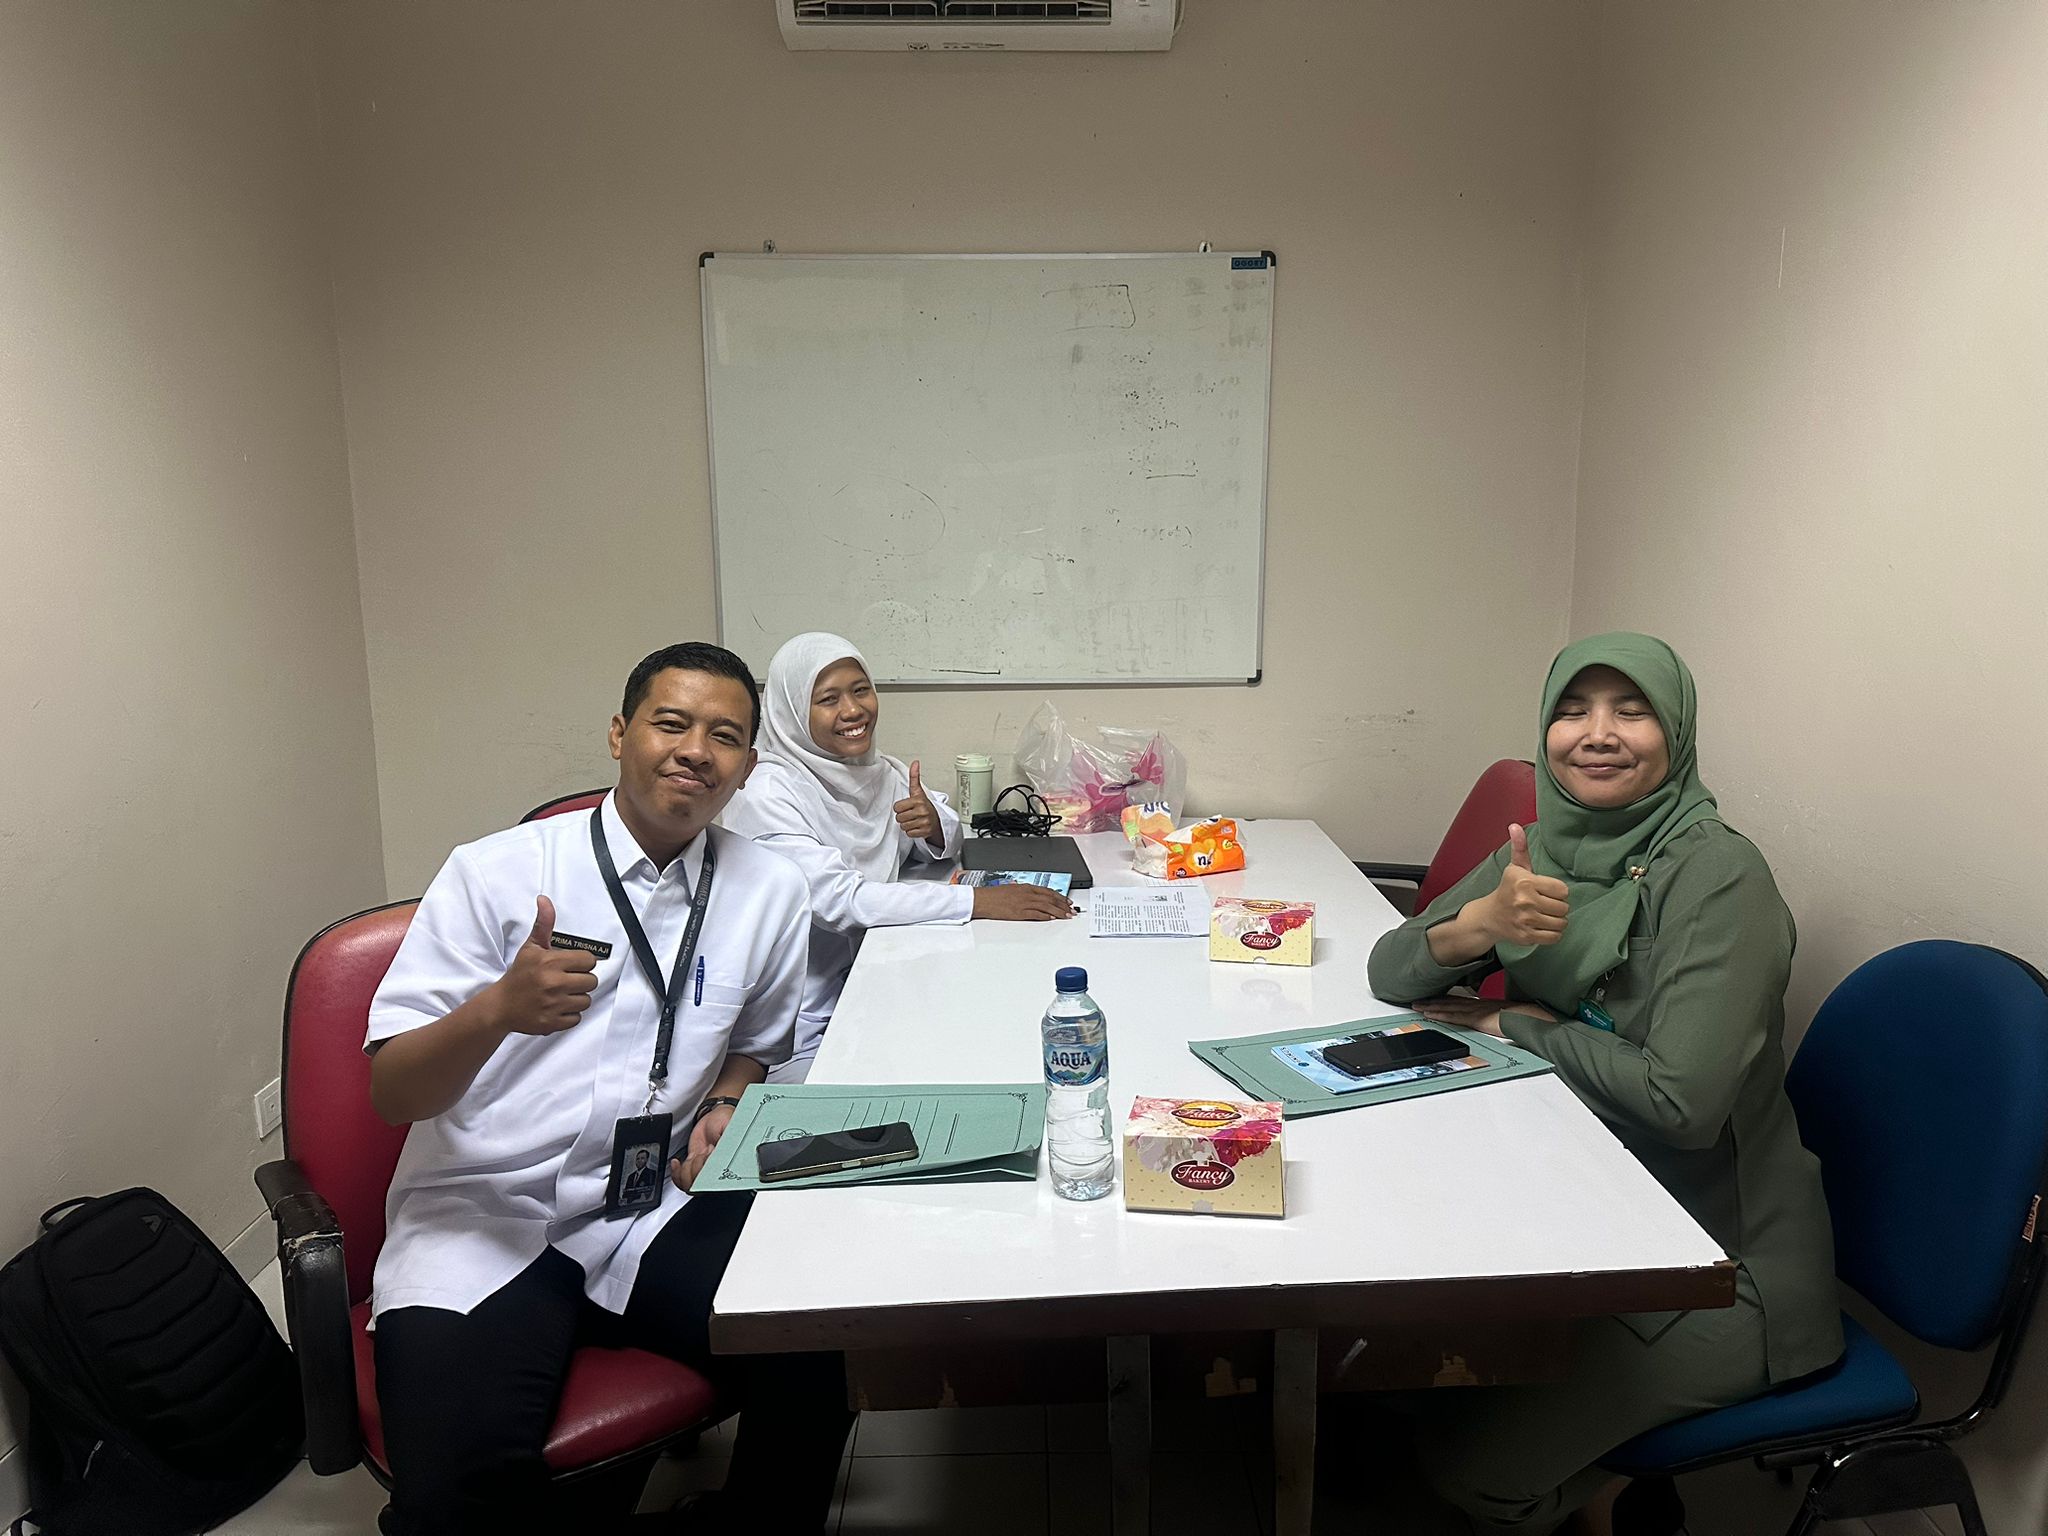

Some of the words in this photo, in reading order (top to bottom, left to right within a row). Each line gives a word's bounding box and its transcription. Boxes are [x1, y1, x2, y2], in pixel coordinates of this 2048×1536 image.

[551, 936, 572, 946] PRIMA
[574, 941, 597, 952] TRISNA
[598, 946, 609, 954] AJI
[1243, 934, 1280, 947] Fancy
[1051, 1050, 1091, 1070] AQUA
[1175, 1164, 1231, 1186] Fancy
